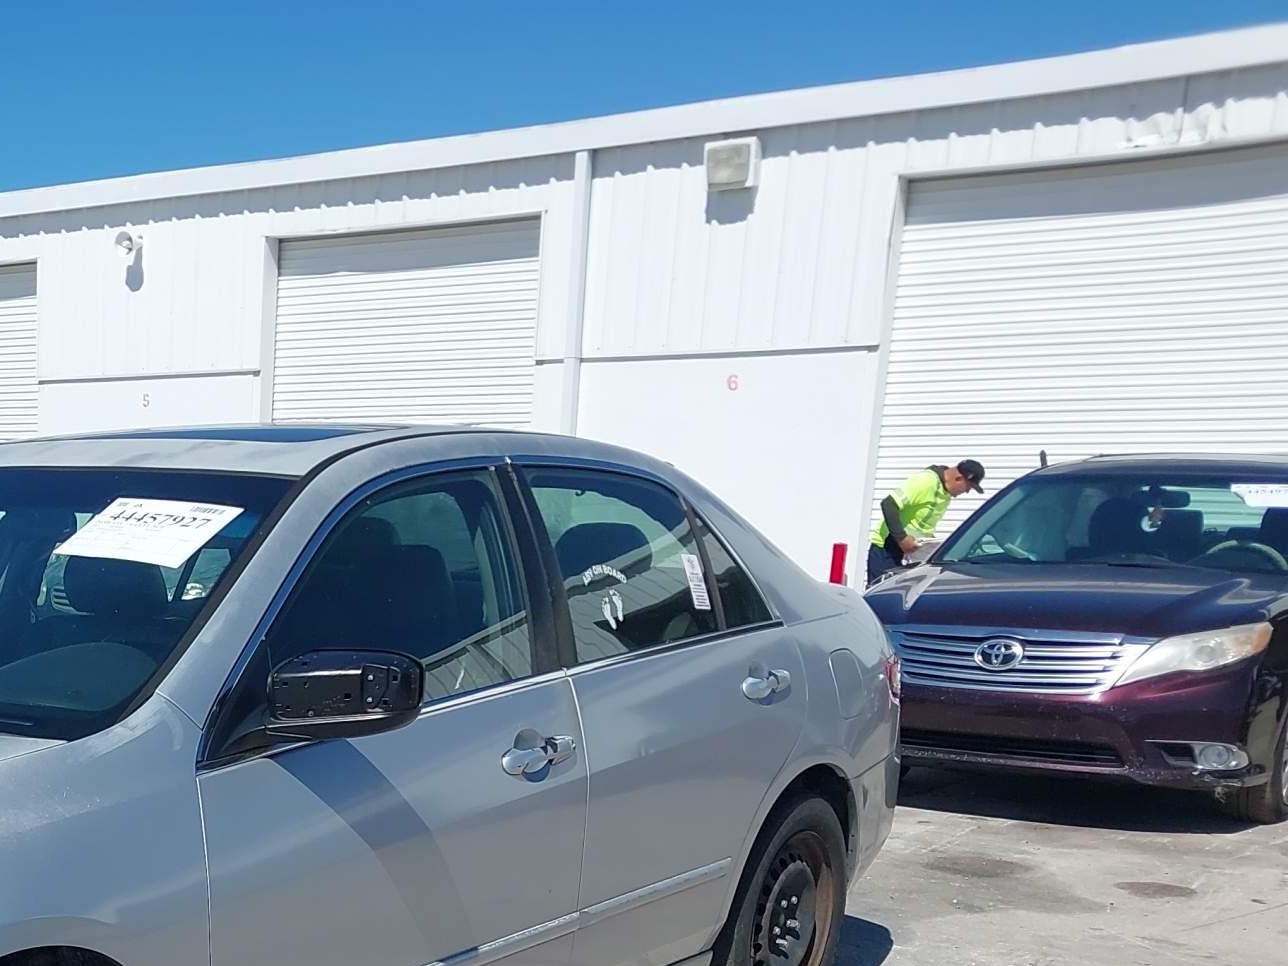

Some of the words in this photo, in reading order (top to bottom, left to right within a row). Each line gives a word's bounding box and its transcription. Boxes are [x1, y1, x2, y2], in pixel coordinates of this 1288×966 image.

[727, 374, 738, 391] 6
[142, 393, 150, 408] 5
[109, 509, 213, 529] 44457927
[602, 564, 628, 584] BOARD
